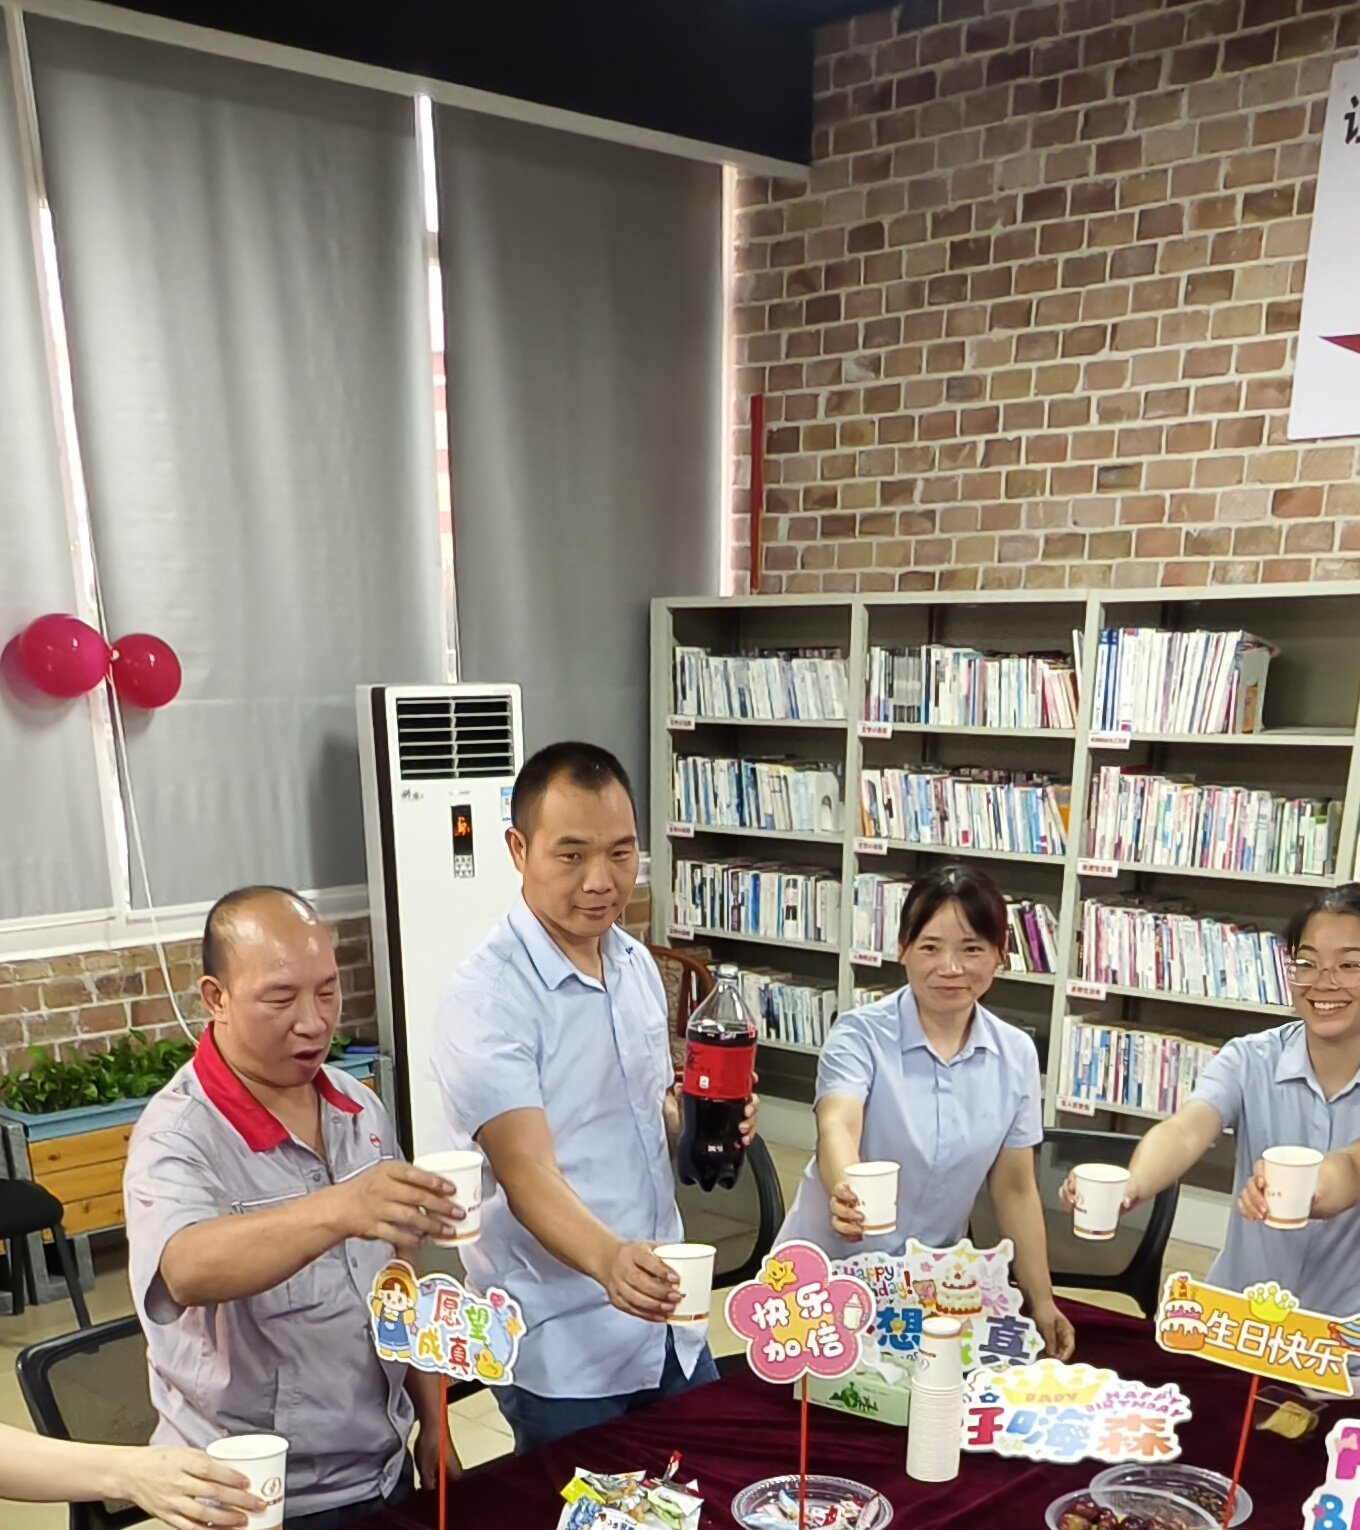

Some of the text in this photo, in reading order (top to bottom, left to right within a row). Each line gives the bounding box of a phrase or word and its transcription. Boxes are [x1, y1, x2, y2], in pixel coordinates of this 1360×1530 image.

[433, 1289, 490, 1342] 愿望
[751, 1282, 833, 1331] 快乐
[418, 1327, 471, 1376] 成真
[1204, 1309, 1344, 1377] 生日快乐
[1085, 1400, 1185, 1418] BIRTHDAY
[1105, 1390, 1183, 1405] HAPPY
